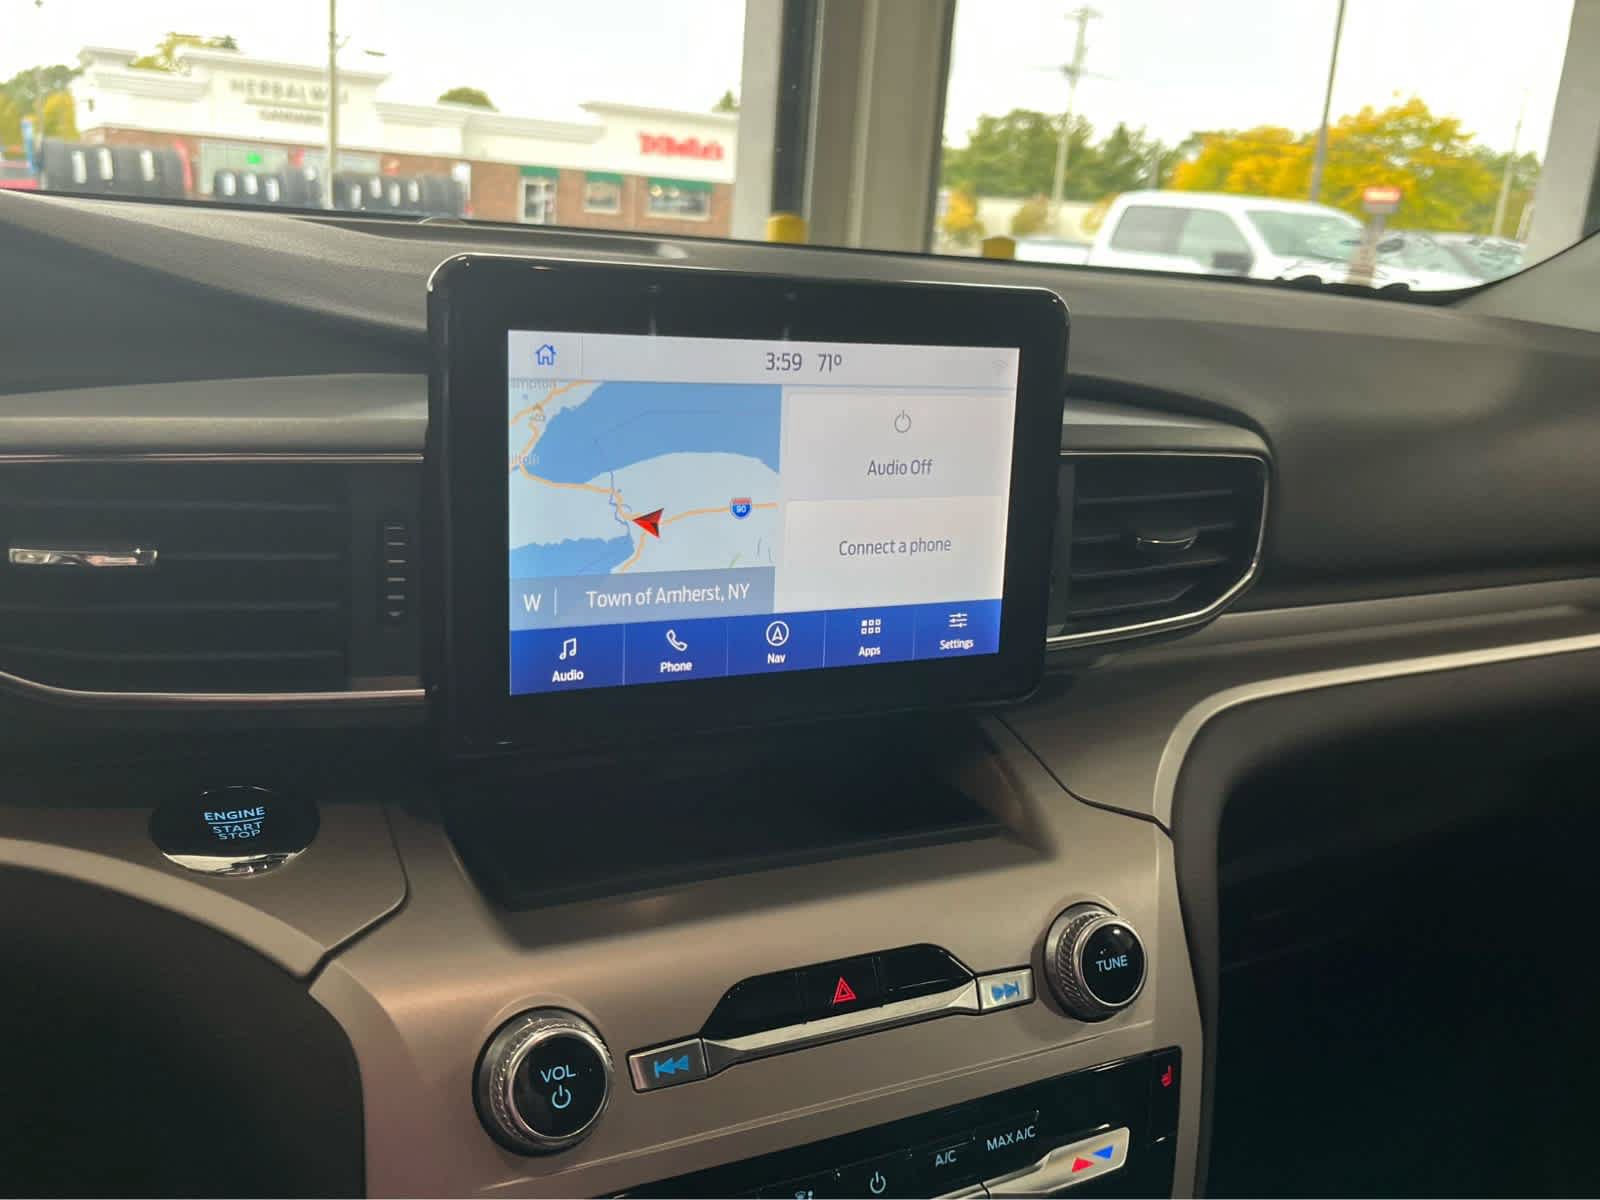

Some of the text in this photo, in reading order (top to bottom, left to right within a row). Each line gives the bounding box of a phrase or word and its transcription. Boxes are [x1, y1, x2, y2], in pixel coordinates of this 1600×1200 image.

[765, 352, 803, 372] 3:59
[867, 458, 933, 476] Audio Off
[839, 536, 952, 556] Connect a phone
[523, 593, 541, 612] W
[585, 583, 750, 609] Town of Amherst, NY
[858, 646, 881, 657] Apps
[939, 638, 974, 651] Settings
[660, 660, 692, 673] Phone
[767, 653, 786, 664] Nav
[552, 669, 584, 683] Audio
[203, 806, 265, 821] ENGINE
[212, 821, 263, 834] START
[218, 830, 261, 840] STOP
[1095, 954, 1128, 972] TUNE
[540, 1064, 577, 1083] VOL
[986, 1125, 1036, 1152] MAX A/C
[935, 1150, 957, 1168] A/C
